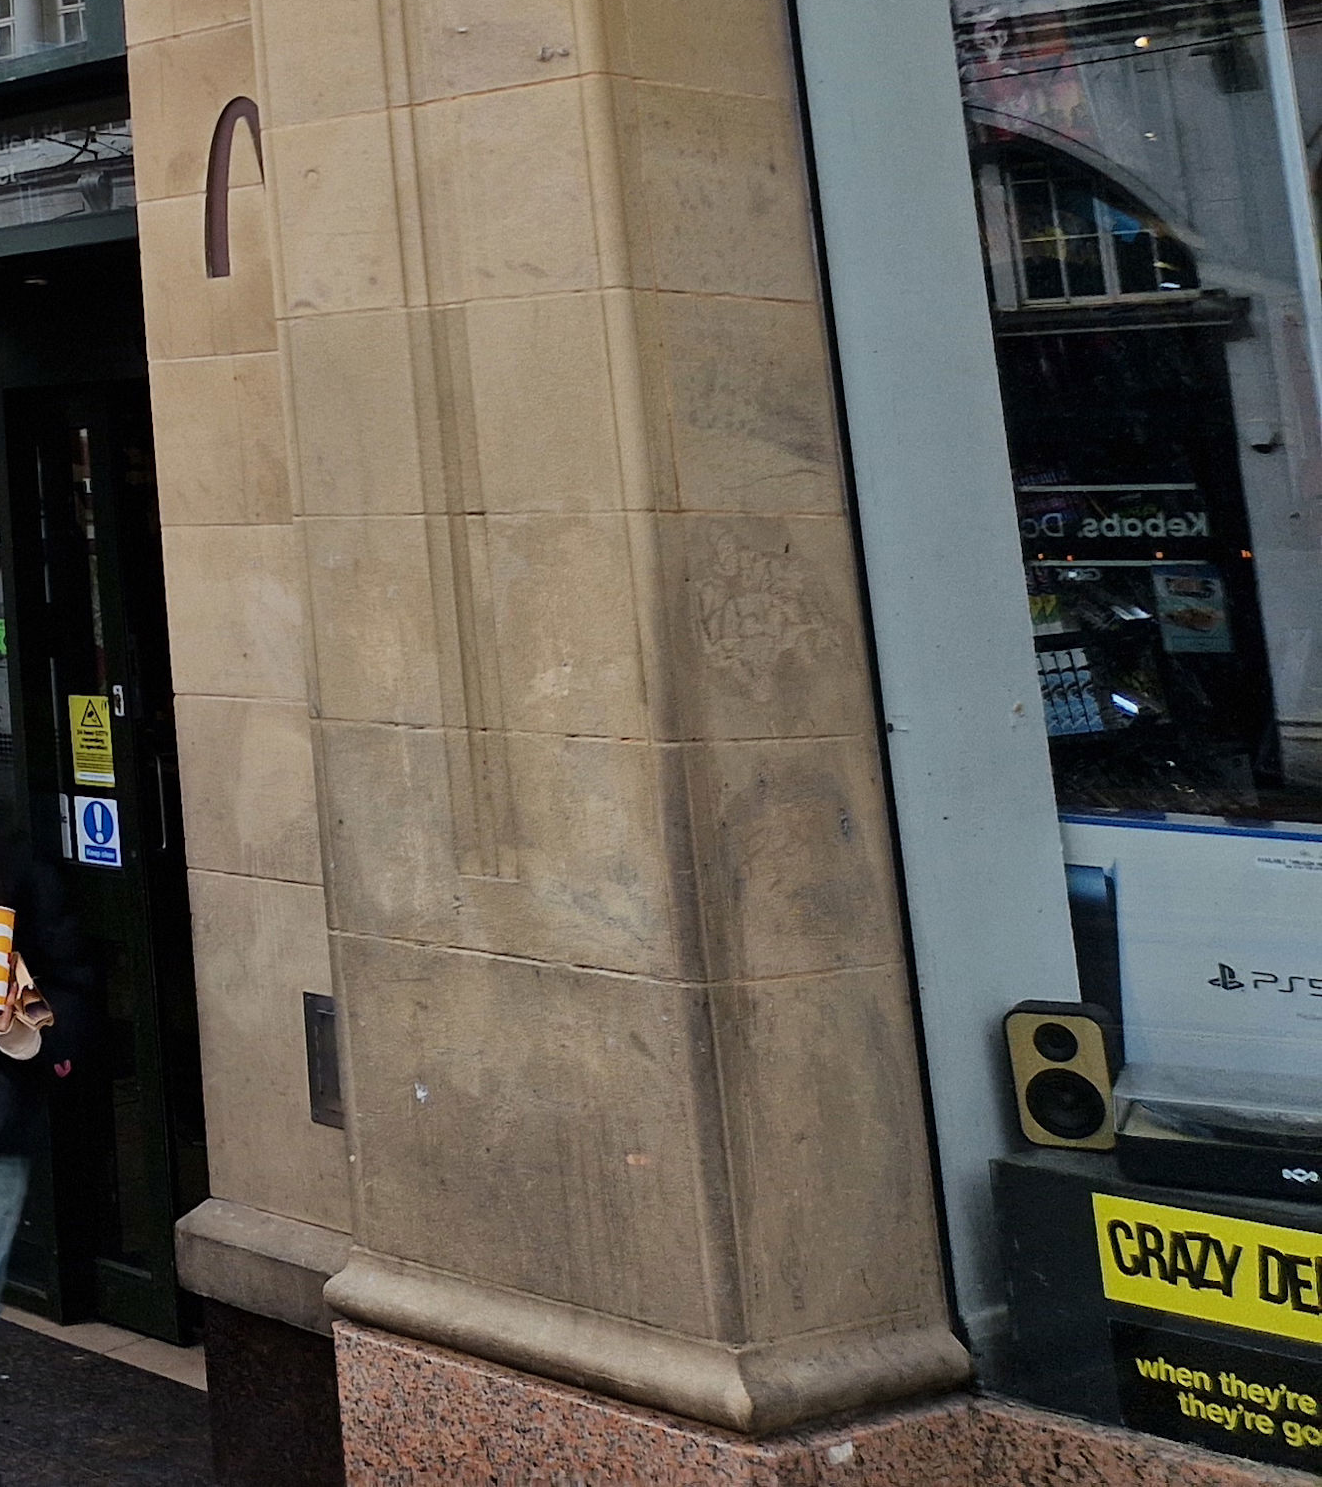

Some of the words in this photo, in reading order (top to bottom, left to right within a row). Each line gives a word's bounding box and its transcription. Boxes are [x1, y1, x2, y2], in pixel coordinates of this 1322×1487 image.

[1107, 1219, 1244, 1299] CRAZY
[1135, 1357, 1213, 1393] when
[1218, 1372, 1318, 1415] they're
[1178, 1391, 1275, 1436] they're
